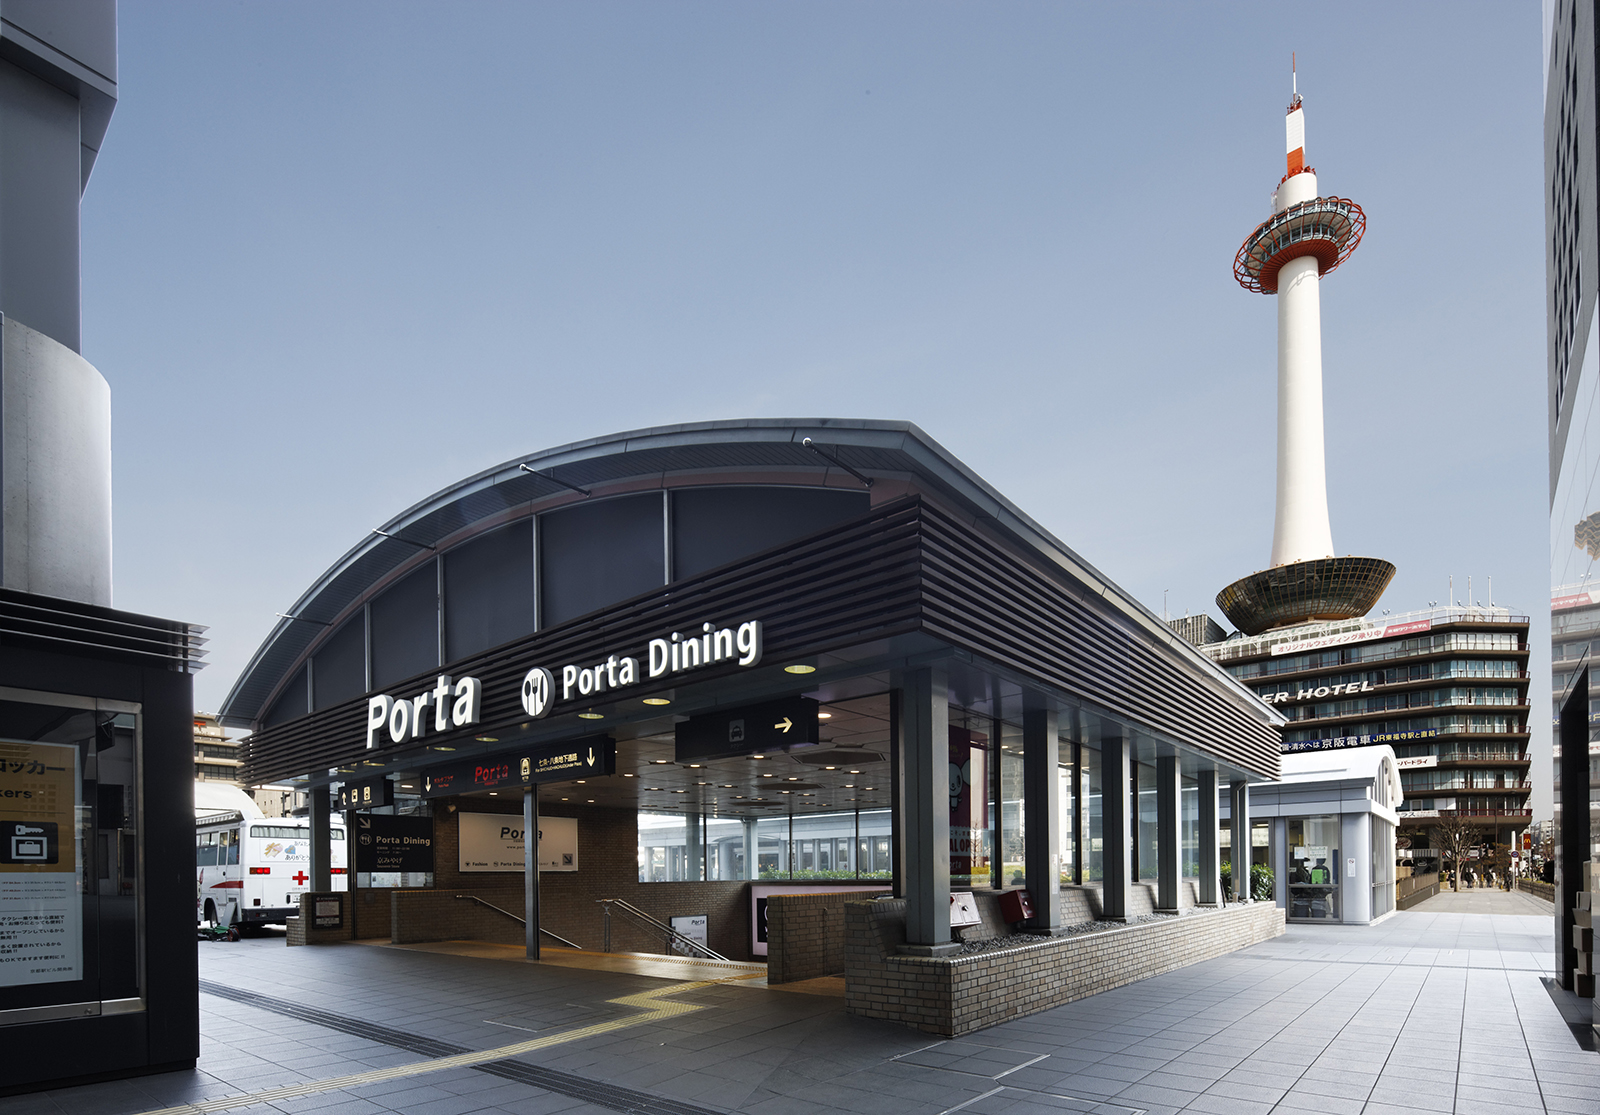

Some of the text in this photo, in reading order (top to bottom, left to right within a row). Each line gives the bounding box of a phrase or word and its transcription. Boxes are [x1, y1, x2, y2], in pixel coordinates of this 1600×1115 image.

[562, 620, 763, 700] Porta Dining
[1296, 680, 1375, 701] HOTEL
[366, 674, 481, 749] Porta
[1321, 733, 1372, 748] 京阪電車
[474, 764, 509, 782] Porta
[376, 836, 431, 846] Porta Dining
